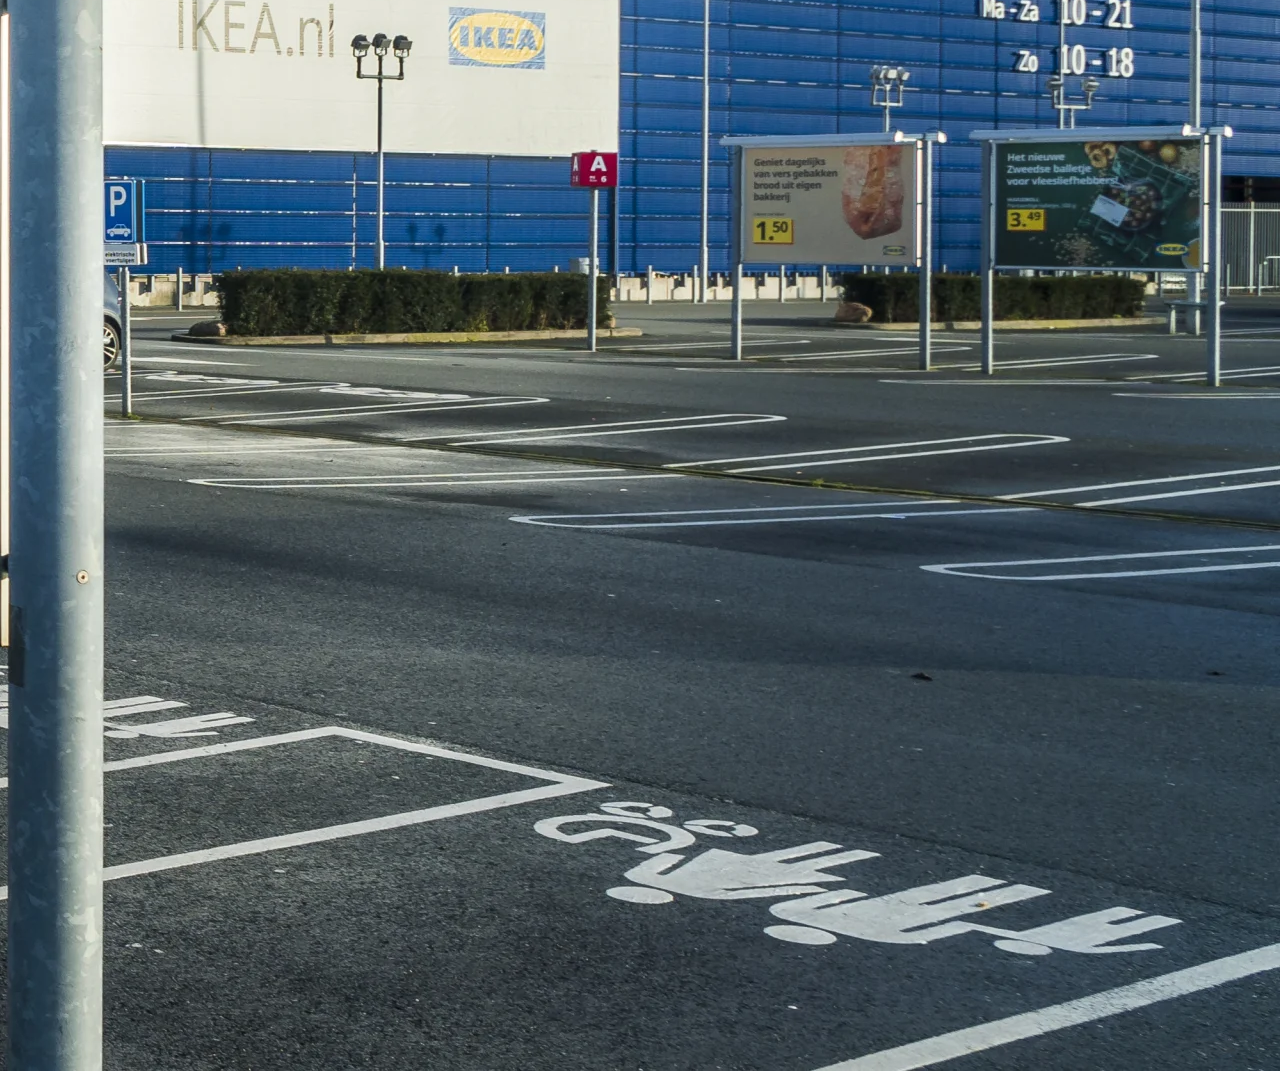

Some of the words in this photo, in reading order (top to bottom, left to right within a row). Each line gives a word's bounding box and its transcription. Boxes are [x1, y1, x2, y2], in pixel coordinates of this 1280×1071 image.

[459, 26, 539, 51] IKEA
[1018, 50, 1038, 73] Zo
[1060, 44, 1086, 75] 10
[1107, 47, 1134, 78] 18
[1007, 153, 1026, 161] Het
[1028, 152, 1065, 161] nieuwe
[590, 156, 607, 171] A
[754, 158, 783, 166] Geniet
[785, 157, 826, 168] dagelijks
[754, 170, 770, 178] van
[772, 170, 791, 178] vers
[793, 169, 838, 179] gebakken
[1007, 165, 1051, 173] Zweedse
[1053, 164, 1092, 175] balletje
[754, 181, 780, 189] brood
[782, 181, 794, 189] uit
[796, 181, 822, 191] eigen
[1006, 178, 1030, 186] voor
[110, 186, 126, 217] P
[754, 193, 790, 203] bakkerij
